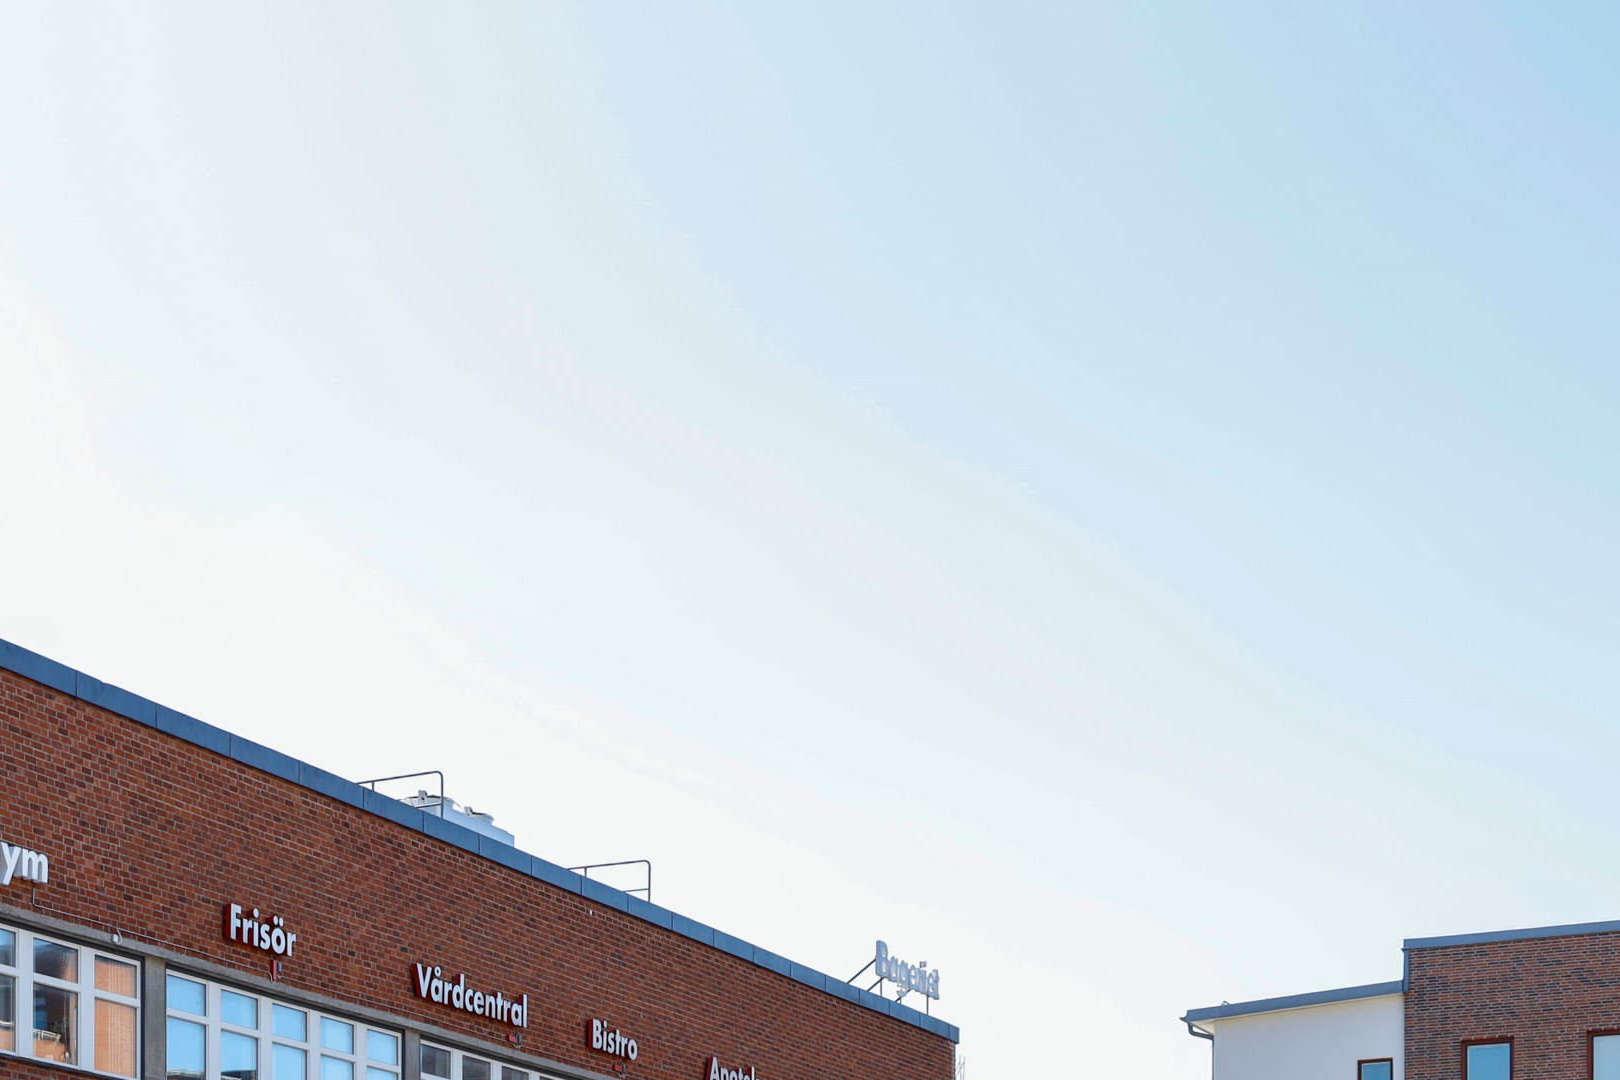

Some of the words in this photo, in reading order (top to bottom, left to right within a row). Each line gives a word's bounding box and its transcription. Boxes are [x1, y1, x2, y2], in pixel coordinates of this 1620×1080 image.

[226, 902, 297, 957] Frisör
[412, 962, 528, 1029] Vårdcentral
[588, 1018, 638, 1061] Bistro
